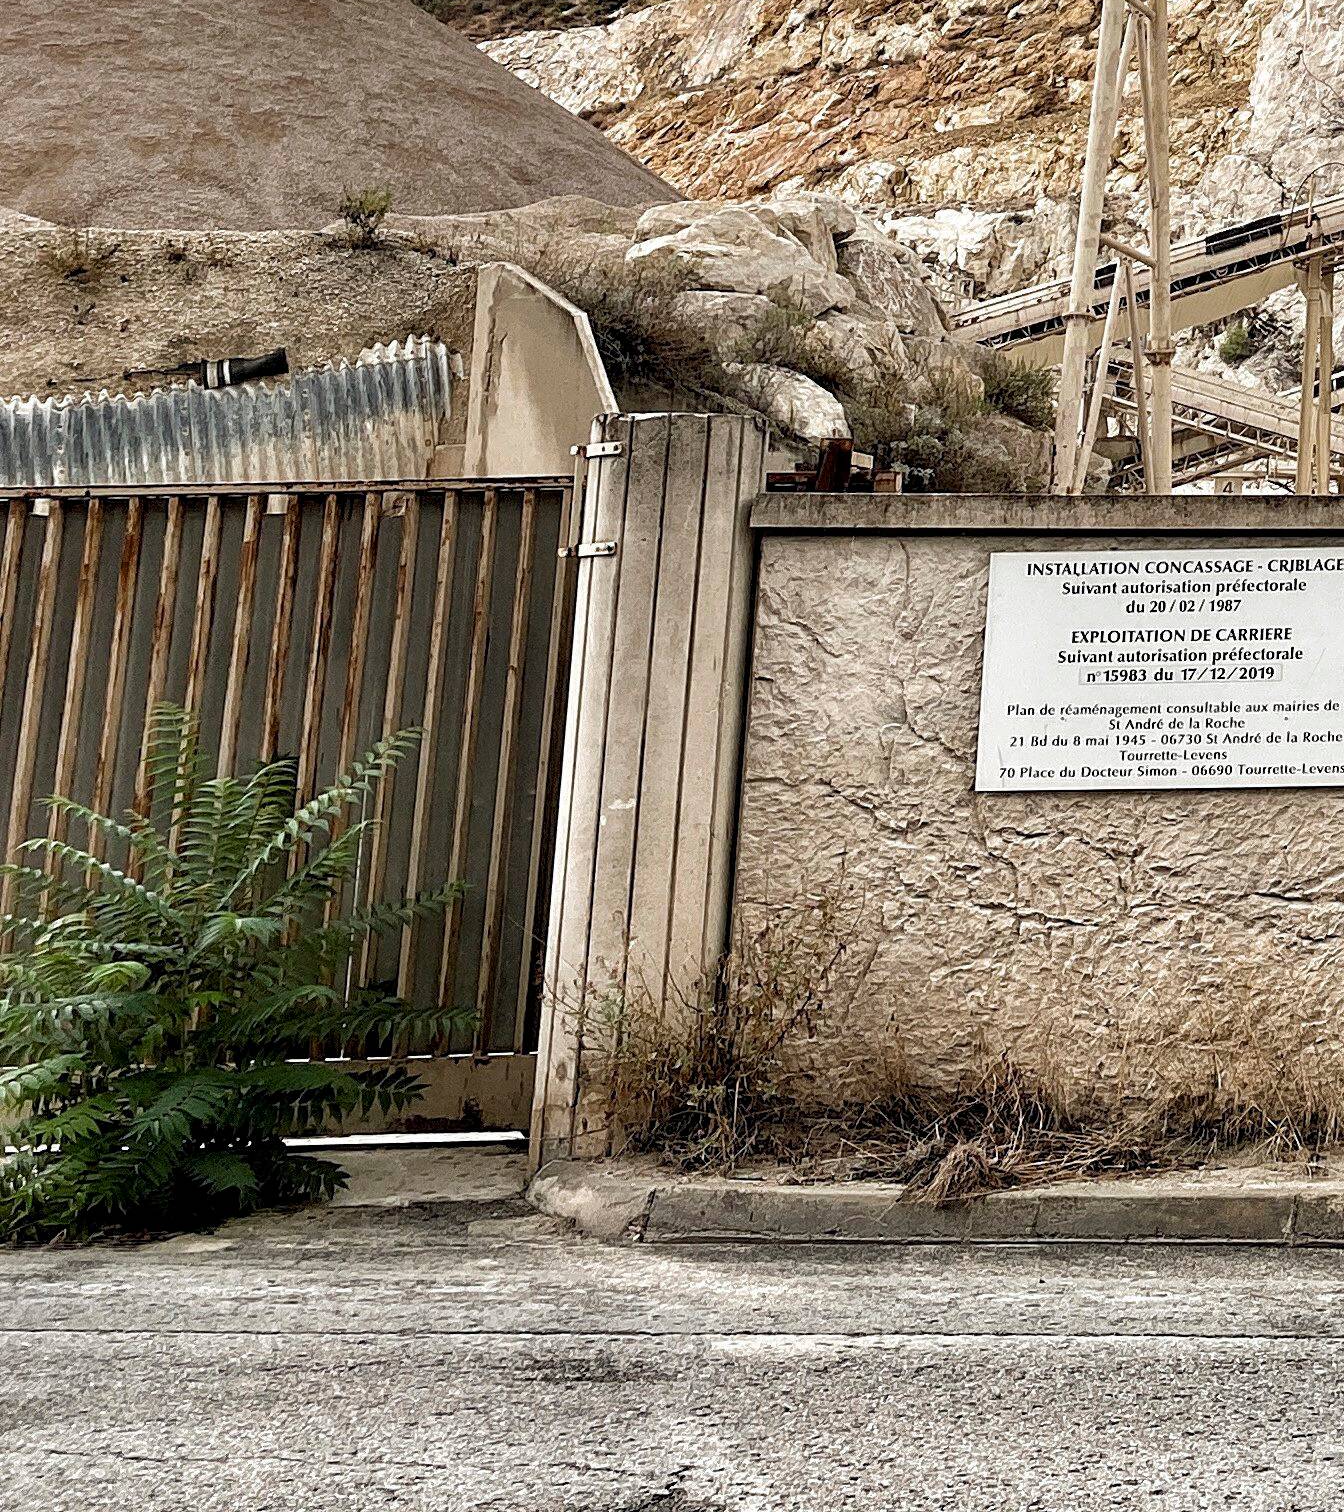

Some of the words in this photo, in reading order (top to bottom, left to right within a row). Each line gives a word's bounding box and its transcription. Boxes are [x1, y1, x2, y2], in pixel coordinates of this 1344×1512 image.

[1027, 562, 1139, 576] INSTALLATION
[1145, 560, 1253, 574] CONCASSAGE
[1267, 558, 1344, 573] CRIBLAGE
[1062, 582, 1117, 594] Suivant
[1121, 580, 1211, 594] autorisation
[1215, 578, 1307, 596] préfectorale
[1126, 600, 1145, 613] du
[1210, 599, 1242, 612] 1987
[1071, 629, 1186, 643] EXPLOITATION
[1191, 629, 1211, 642] DE
[1215, 628, 1293, 642] CARRIERE
[1058, 650, 1113, 663] Suivant
[1117, 648, 1207, 663] autorisation
[1212, 647, 1304, 665] préfectorale
[1153, 668, 1173, 681] du
[1007, 704, 1035, 716] Plan
[1039, 704, 1056, 716] de
[1060, 703, 1162, 718] réaménagement
[1167, 701, 1241, 714] consultable
[1245, 703, 1269, 713] aux
[1273, 700, 1320, 713] mairies
[1324, 699, 1340, 712] de
[1109, 719, 1121, 730] St
[1125, 718, 1164, 730] André
[1168, 718, 1185, 730] de
[1189, 717, 1200, 729] la
[1205, 717, 1246, 729] Roche
[1010, 736, 1024, 747] 21
[1031, 735, 1047, 747] Bd
[1052, 735, 1068, 747] du
[1073, 736, 1081, 746] 8
[1085, 734, 1109, 746] mai
[1115, 735, 1146, 746] 1945
[1161, 734, 1202, 745] 06730
[1206, 733, 1218, 744] St
[1222, 732, 1261, 744] André
[1266, 732, 1282, 744] de
[1286, 731, 1298, 743] la
[1303, 731, 1343, 743] Roche
[1119, 749, 1228, 761] Tourrette-Levens
[999, 767, 1015, 778] 70
[1020, 767, 1055, 778] Place
[1059, 767, 1076, 778] du
[1081, 766, 1133, 778] Docteur
[1137, 765, 1177, 777] Simon
[1191, 765, 1233, 776] 06690
